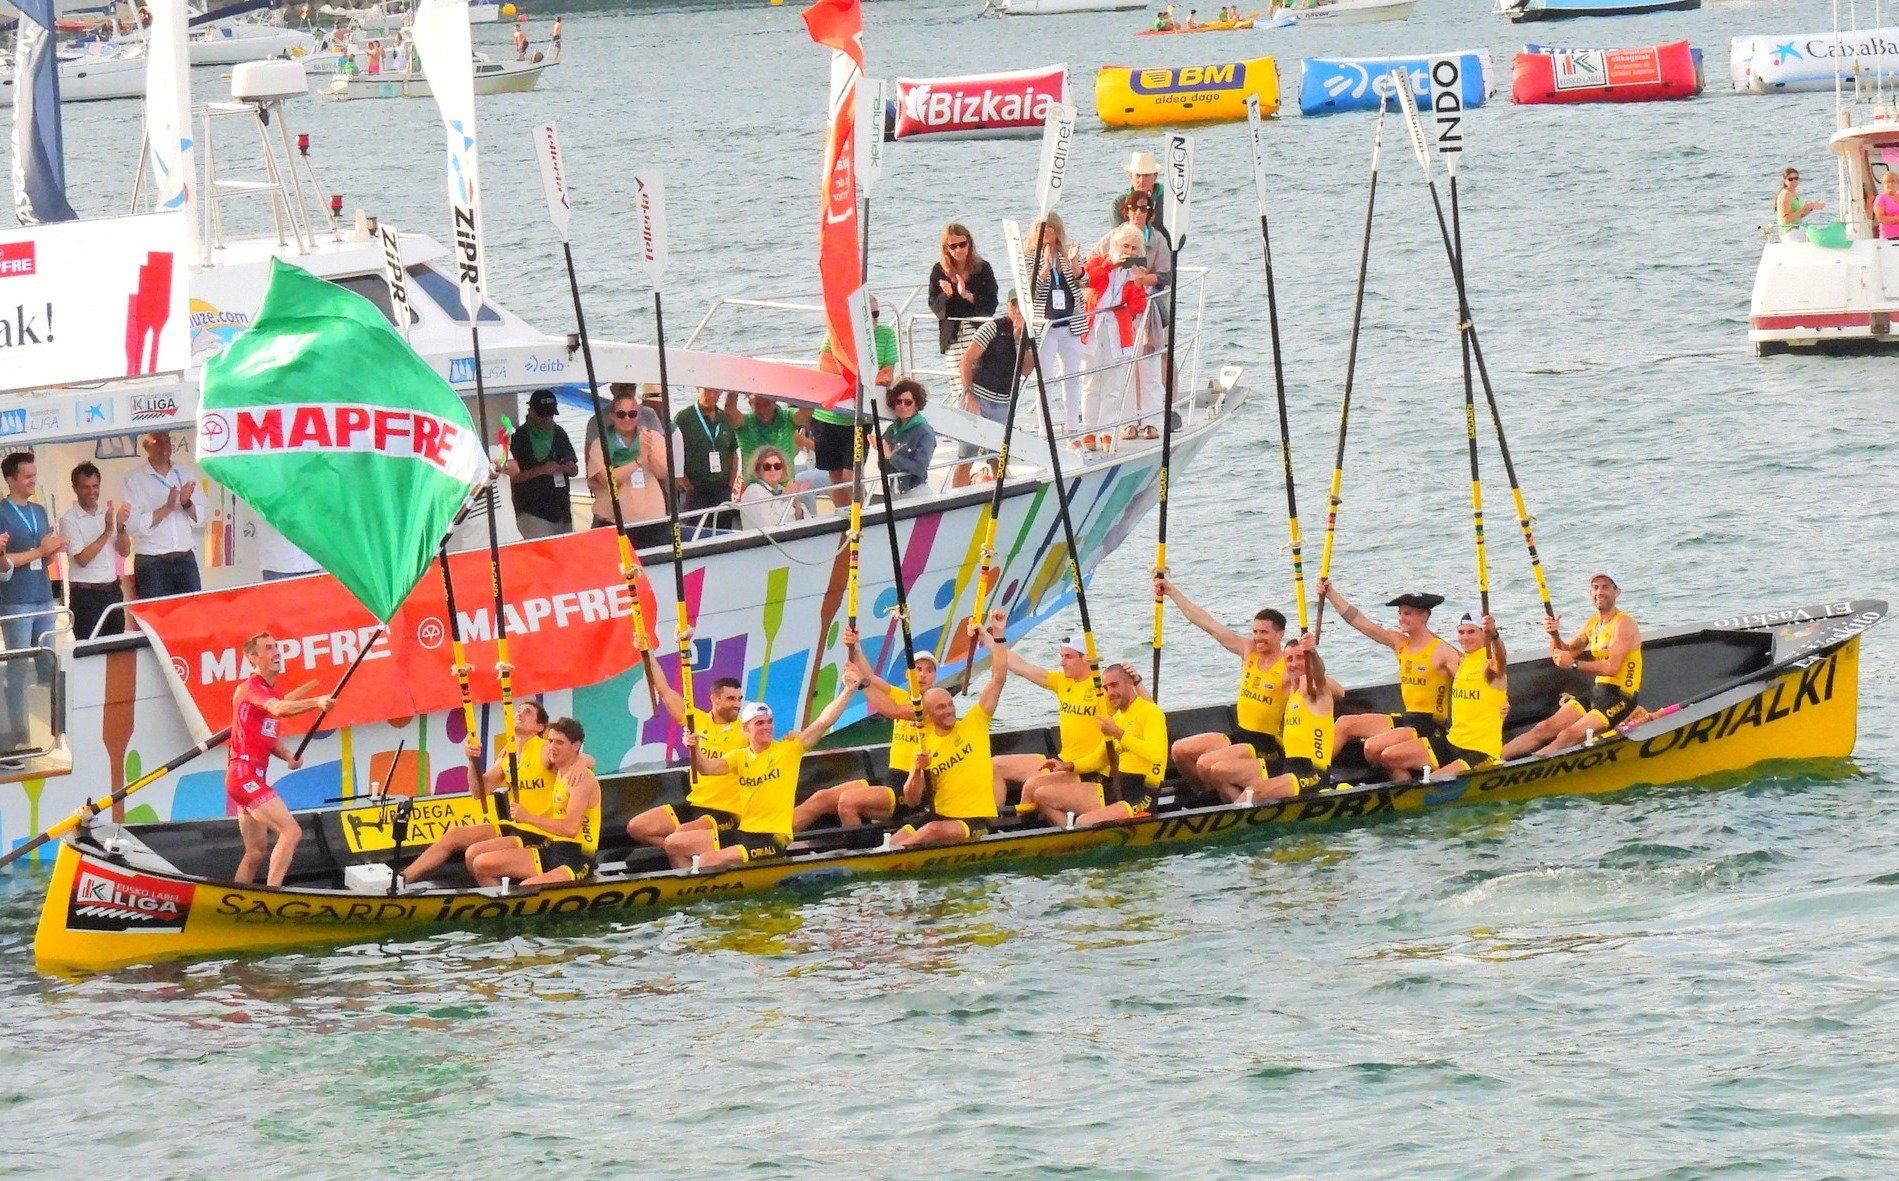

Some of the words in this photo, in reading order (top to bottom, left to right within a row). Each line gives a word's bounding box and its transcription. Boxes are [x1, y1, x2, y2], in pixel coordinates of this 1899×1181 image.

[1178, 64, 1236, 86] BM
[930, 88, 1054, 127] Bizkaia
[1155, 94, 1190, 104] aldea
[1192, 92, 1220, 104] dago
[1432, 60, 1463, 154] INDO
[1051, 119, 1072, 189] aldinet
[0, 258, 33, 273] FRE
[189, 309, 250, 327] uze.com
[540, 359, 565, 372] eitb
[147, 398, 176, 411] LIGA
[236, 406, 459, 467] MAPFRE
[998, 442, 1009, 479] SAGARDI
[1160, 467, 1168, 502] SAGARDI
[456, 583, 633, 644] MAPFRE
[1713, 607, 1814, 628] Vaskito
[1060, 701, 1097, 717] RIALKI
[1639, 653, 1838, 759] ORIALKI
[930, 742, 974, 777] ORIALKI
[1314, 728, 1324, 760] ORIO
[1478, 745, 1627, 792] ORBINOX
[1153, 803, 1290, 841] INDO
[114, 891, 178, 913] LIGA
[116, 882, 150, 897] EUSKO
[151, 890, 180, 901] LABEL
[216, 893, 418, 921] SAGARDI
